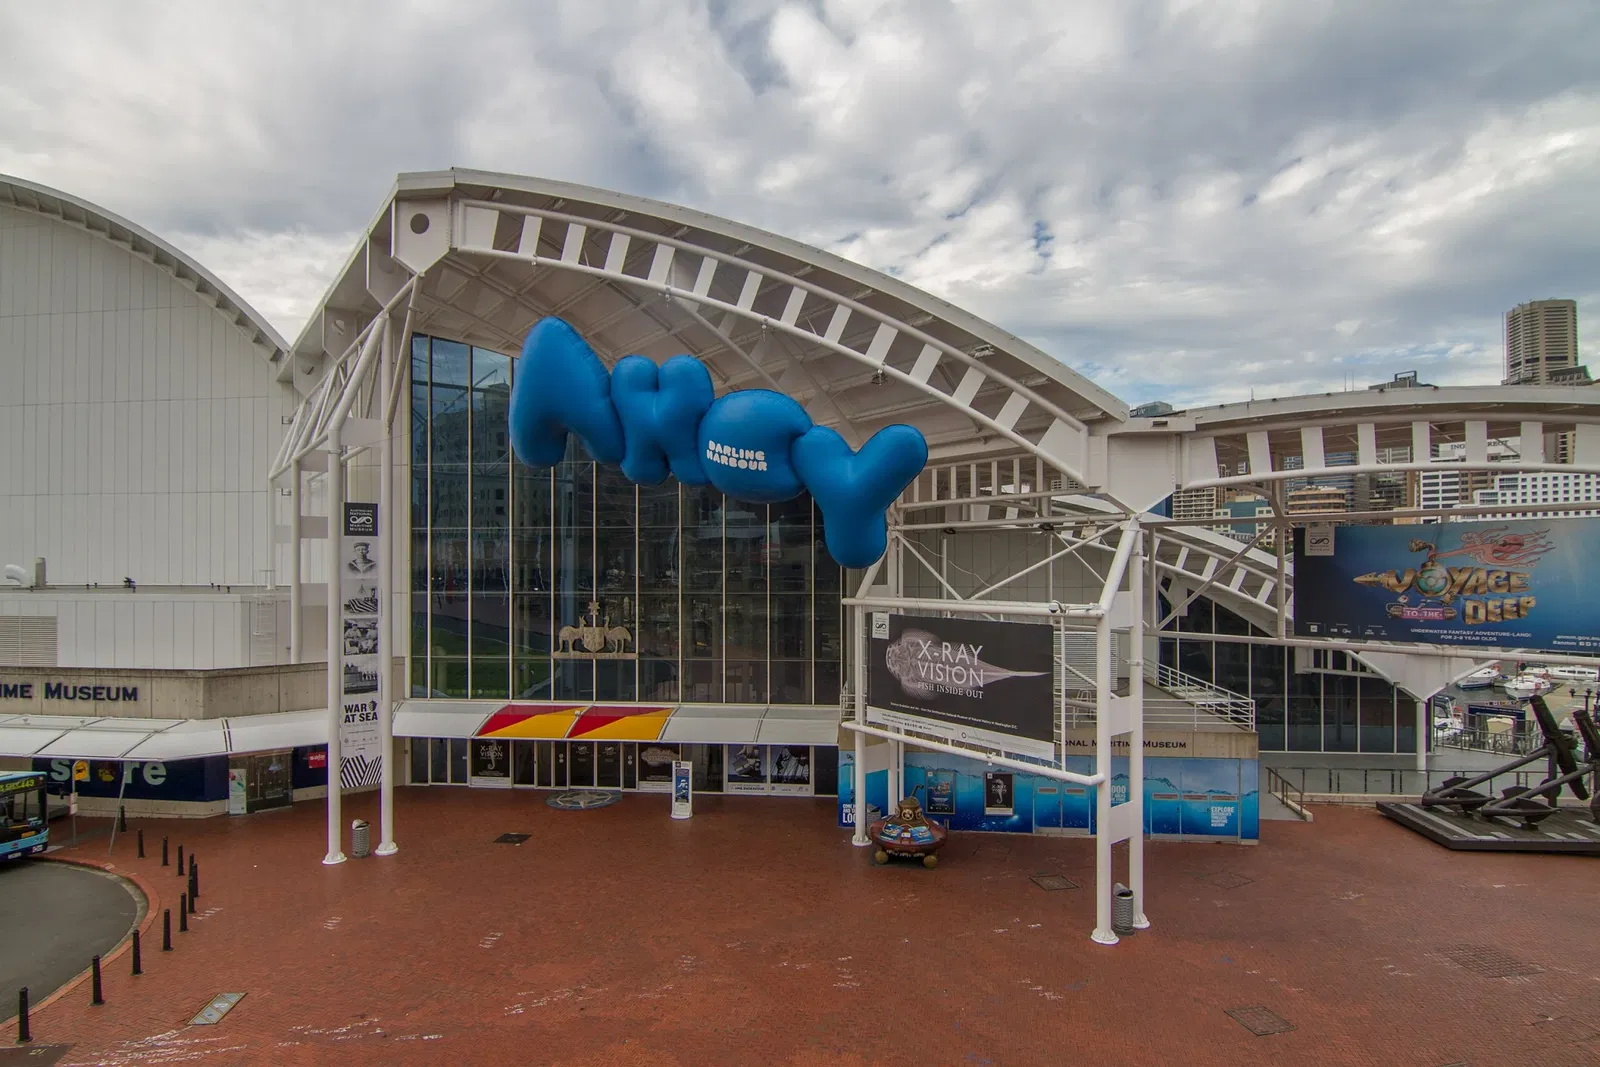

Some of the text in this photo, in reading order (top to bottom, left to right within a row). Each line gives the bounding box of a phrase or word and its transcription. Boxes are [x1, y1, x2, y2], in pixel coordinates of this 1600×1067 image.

[708, 440, 765, 460] DARLING
[706, 450, 768, 471] HARBOUR
[1388, 567, 1531, 597] VOYAGE
[1464, 597, 1537, 625] DEEP
[918, 640, 983, 665] X-RAY
[918, 661, 983, 687] VISION
[45, 682, 138, 701] MUSEUM
[917, 682, 983, 698] FISH INSIDE OUT
[344, 703, 367, 713] WAR
[344, 712, 378, 723] AT SEA
